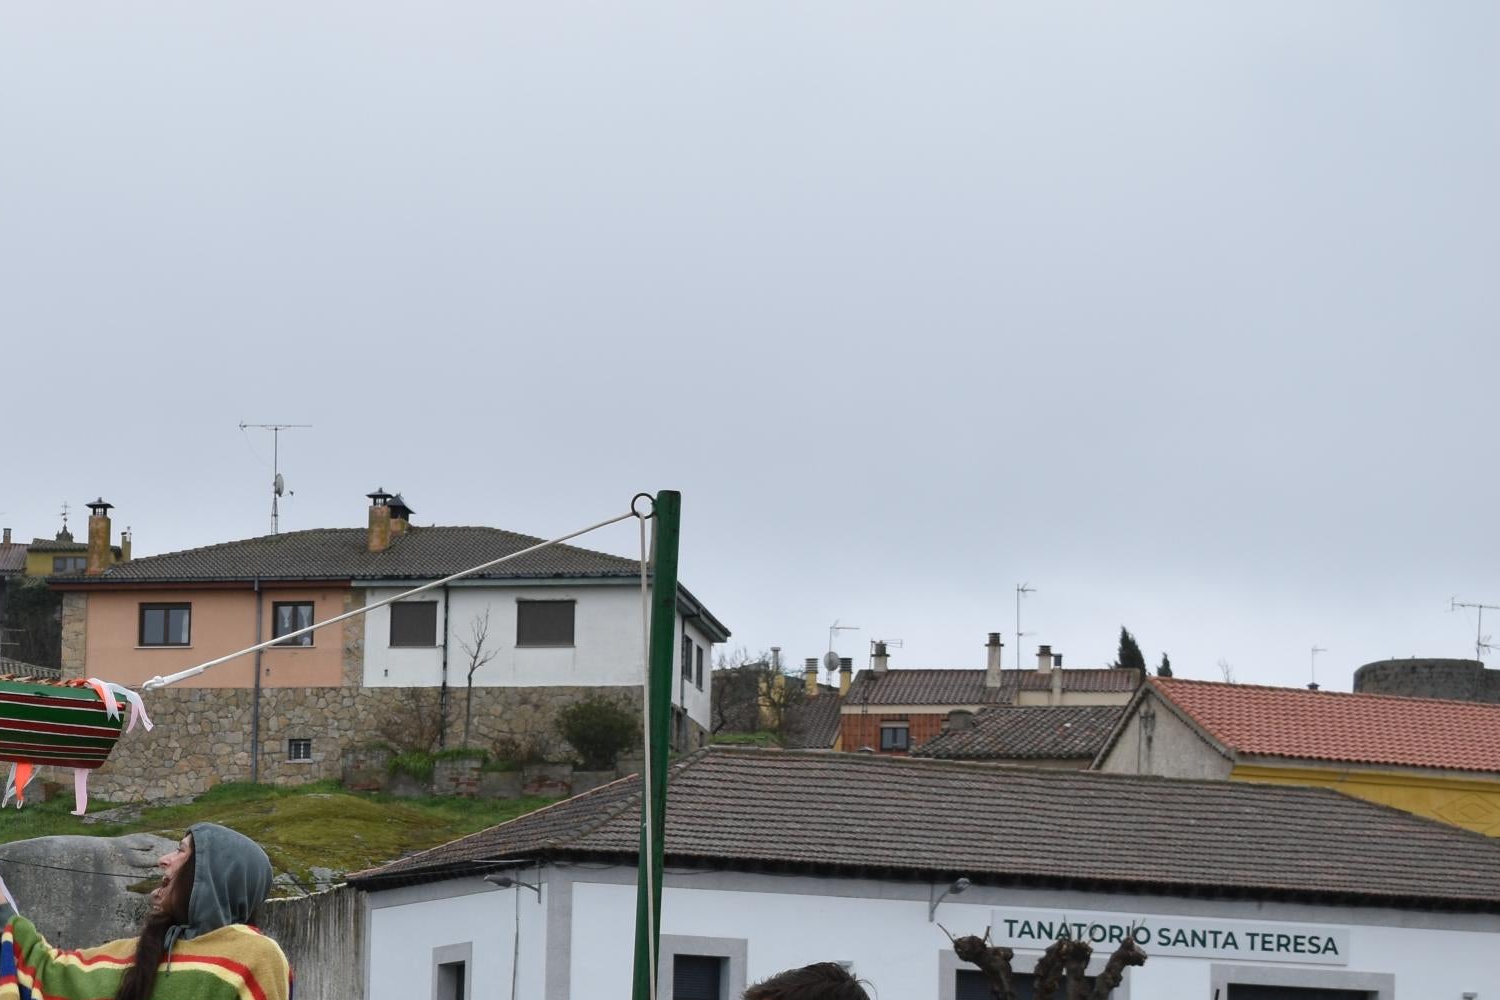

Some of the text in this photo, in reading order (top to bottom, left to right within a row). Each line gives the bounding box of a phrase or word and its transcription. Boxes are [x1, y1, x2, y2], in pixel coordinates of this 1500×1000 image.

[1003, 919, 1339, 956] TANATORIO SANTA TERESA
